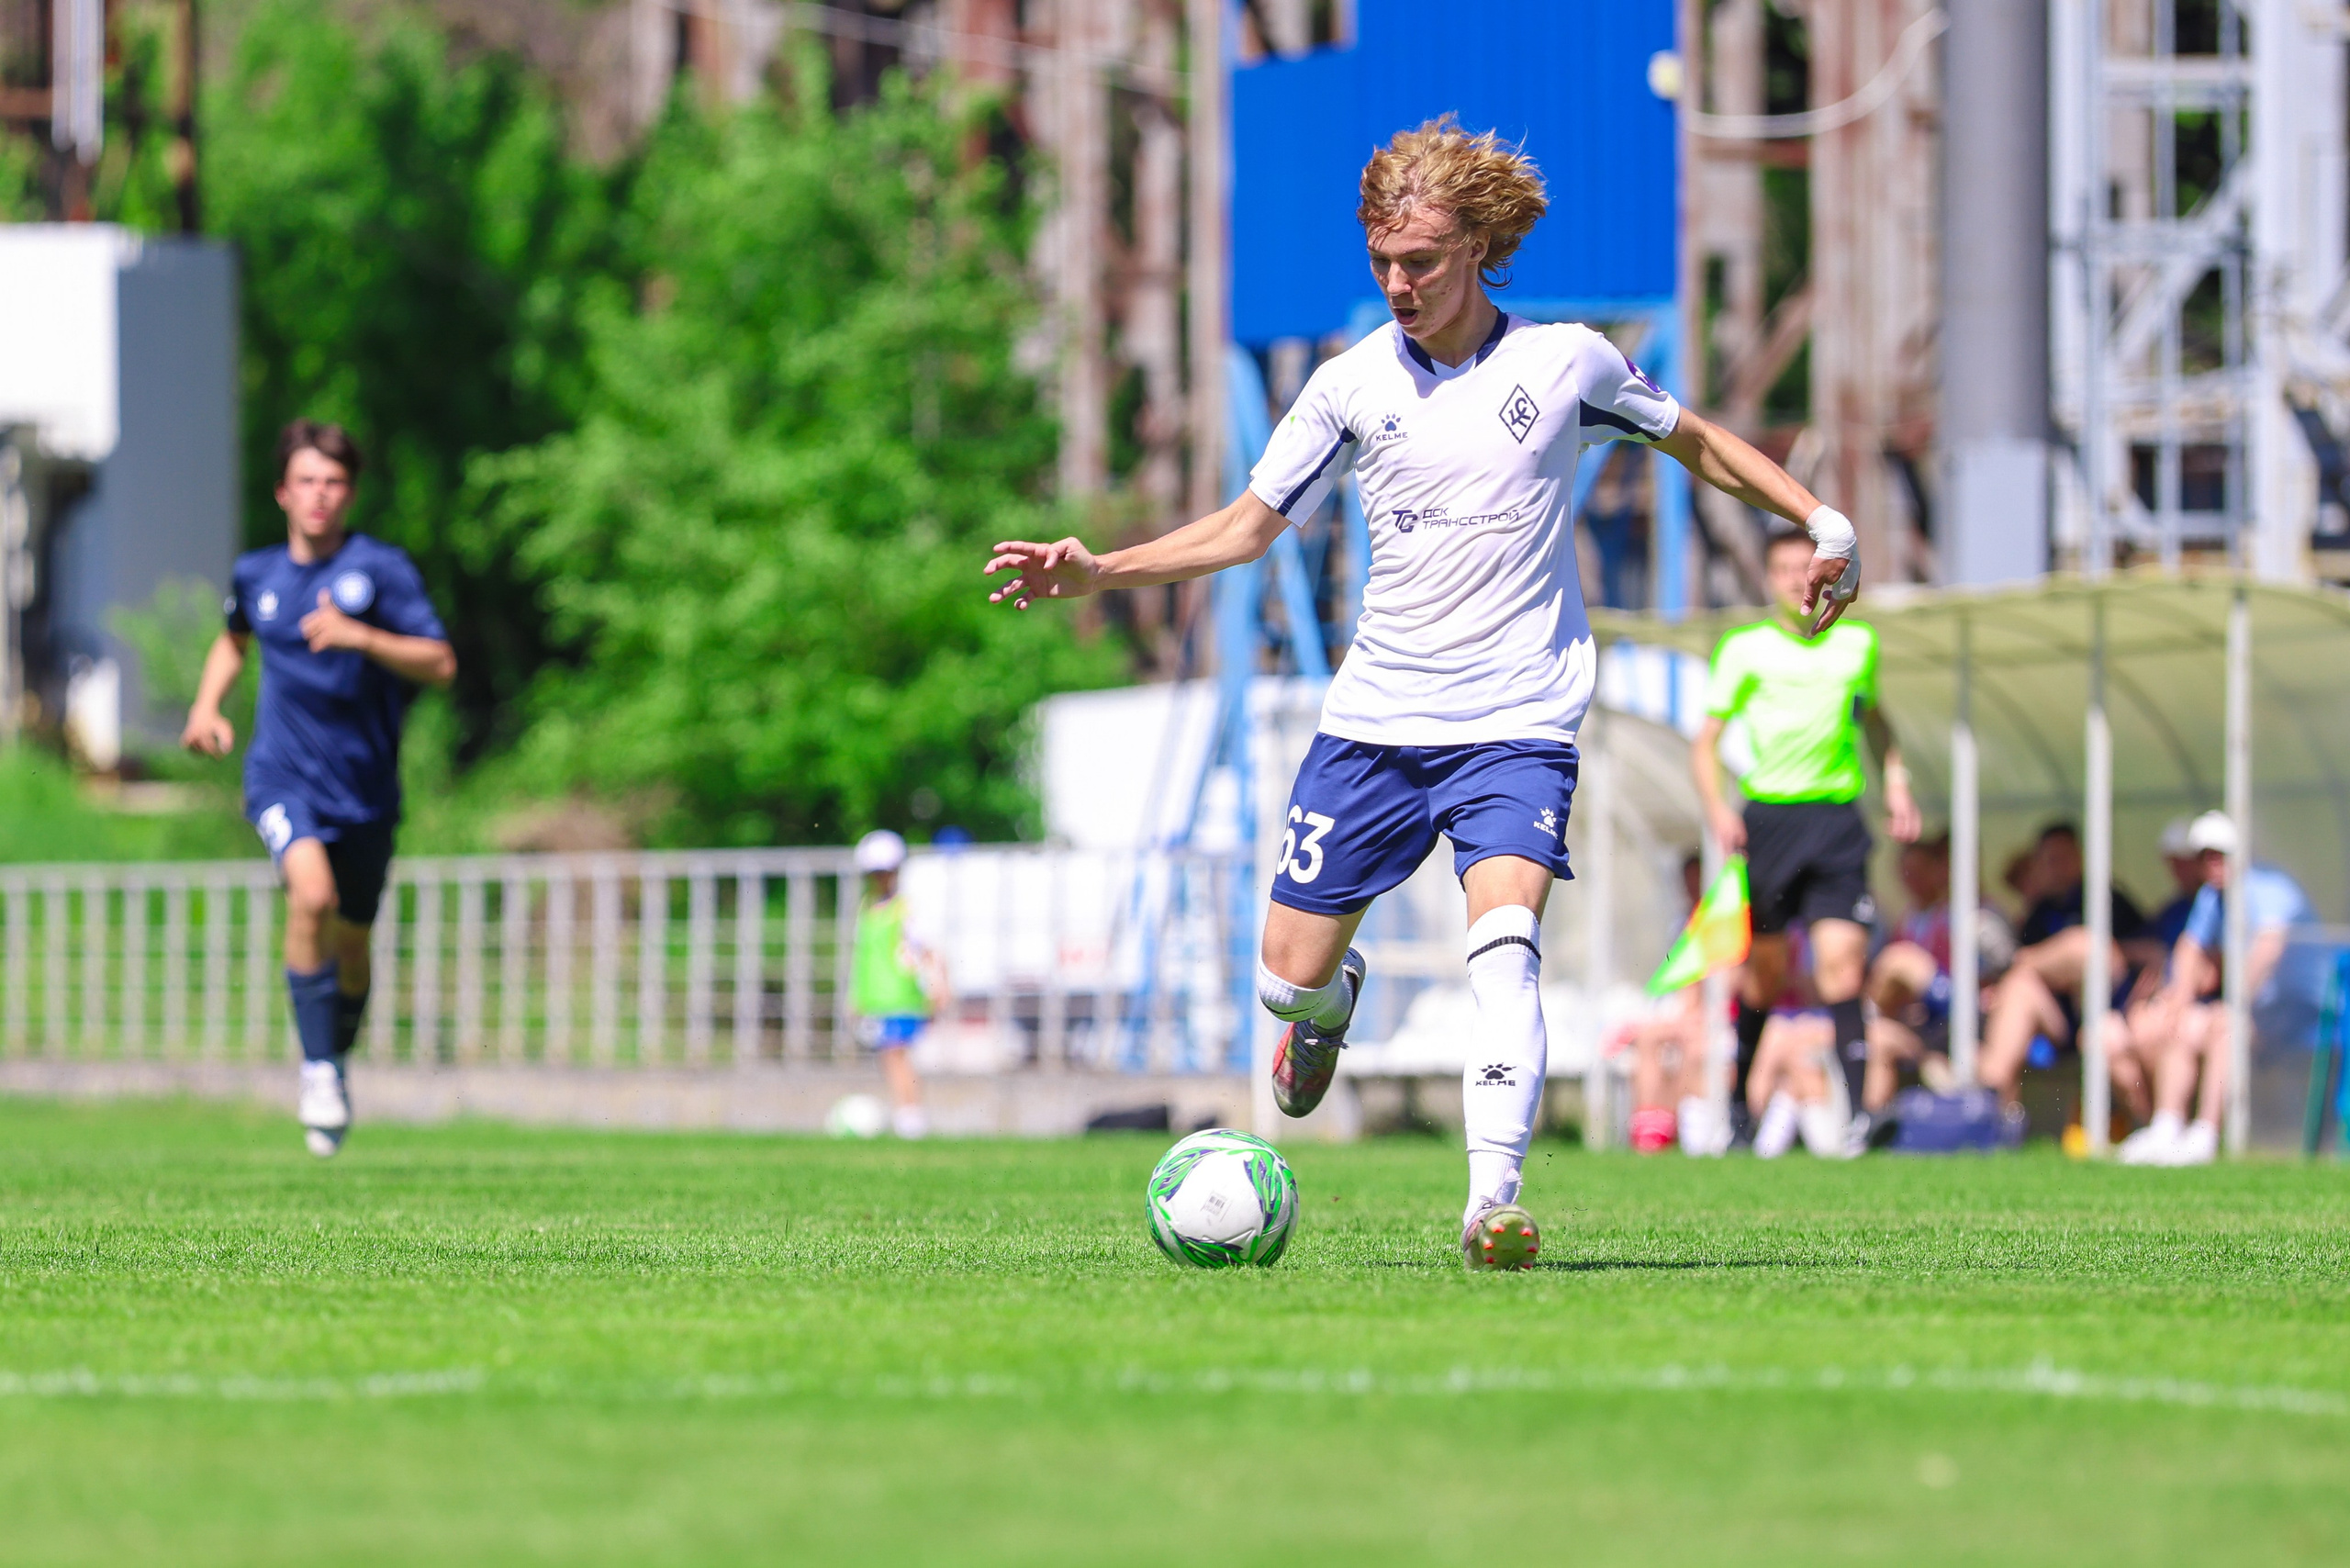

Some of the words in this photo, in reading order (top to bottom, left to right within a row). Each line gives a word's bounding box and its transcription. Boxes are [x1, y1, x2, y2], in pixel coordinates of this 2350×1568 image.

[1376, 431, 1408, 442] KELME
[1422, 508, 1449, 519] ДСК
[1422, 510, 1520, 530] ТРАНССТРОЙ
[1276, 804, 1336, 884] 63
